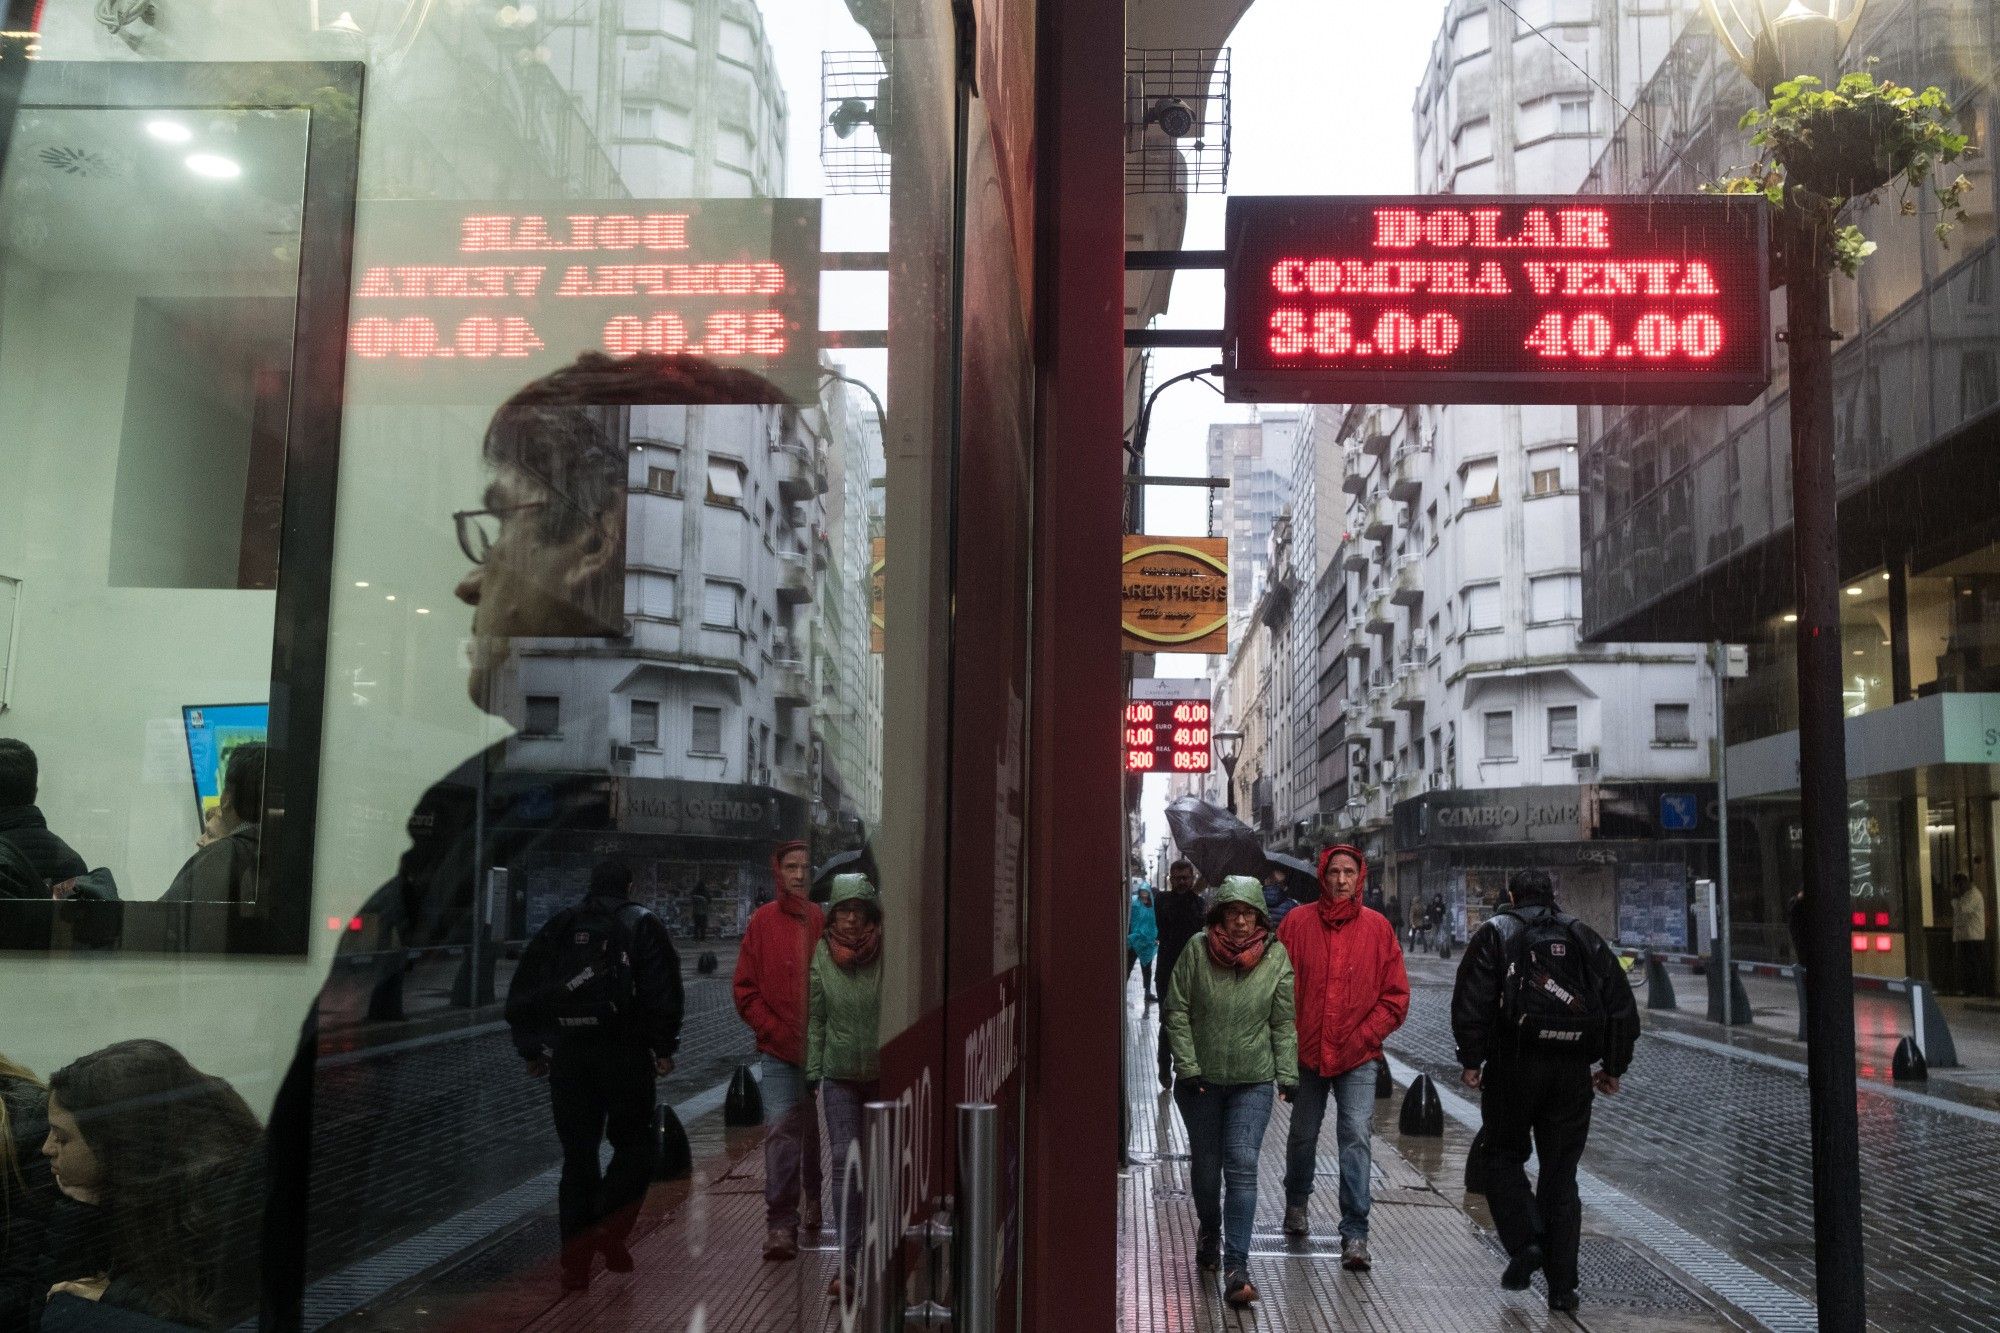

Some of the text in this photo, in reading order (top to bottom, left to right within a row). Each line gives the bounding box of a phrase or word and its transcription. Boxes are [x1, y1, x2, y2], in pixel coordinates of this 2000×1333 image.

[1373, 207, 1610, 249] DOLAR
[1271, 259, 1721, 296] COMPRA VENTA
[1269, 308, 1725, 358] 38.00 40.00
[1437, 806, 1519, 826] CAMBIO
[1544, 978, 1575, 1005] SPORT
[1538, 1029, 1583, 1041] SPORT
